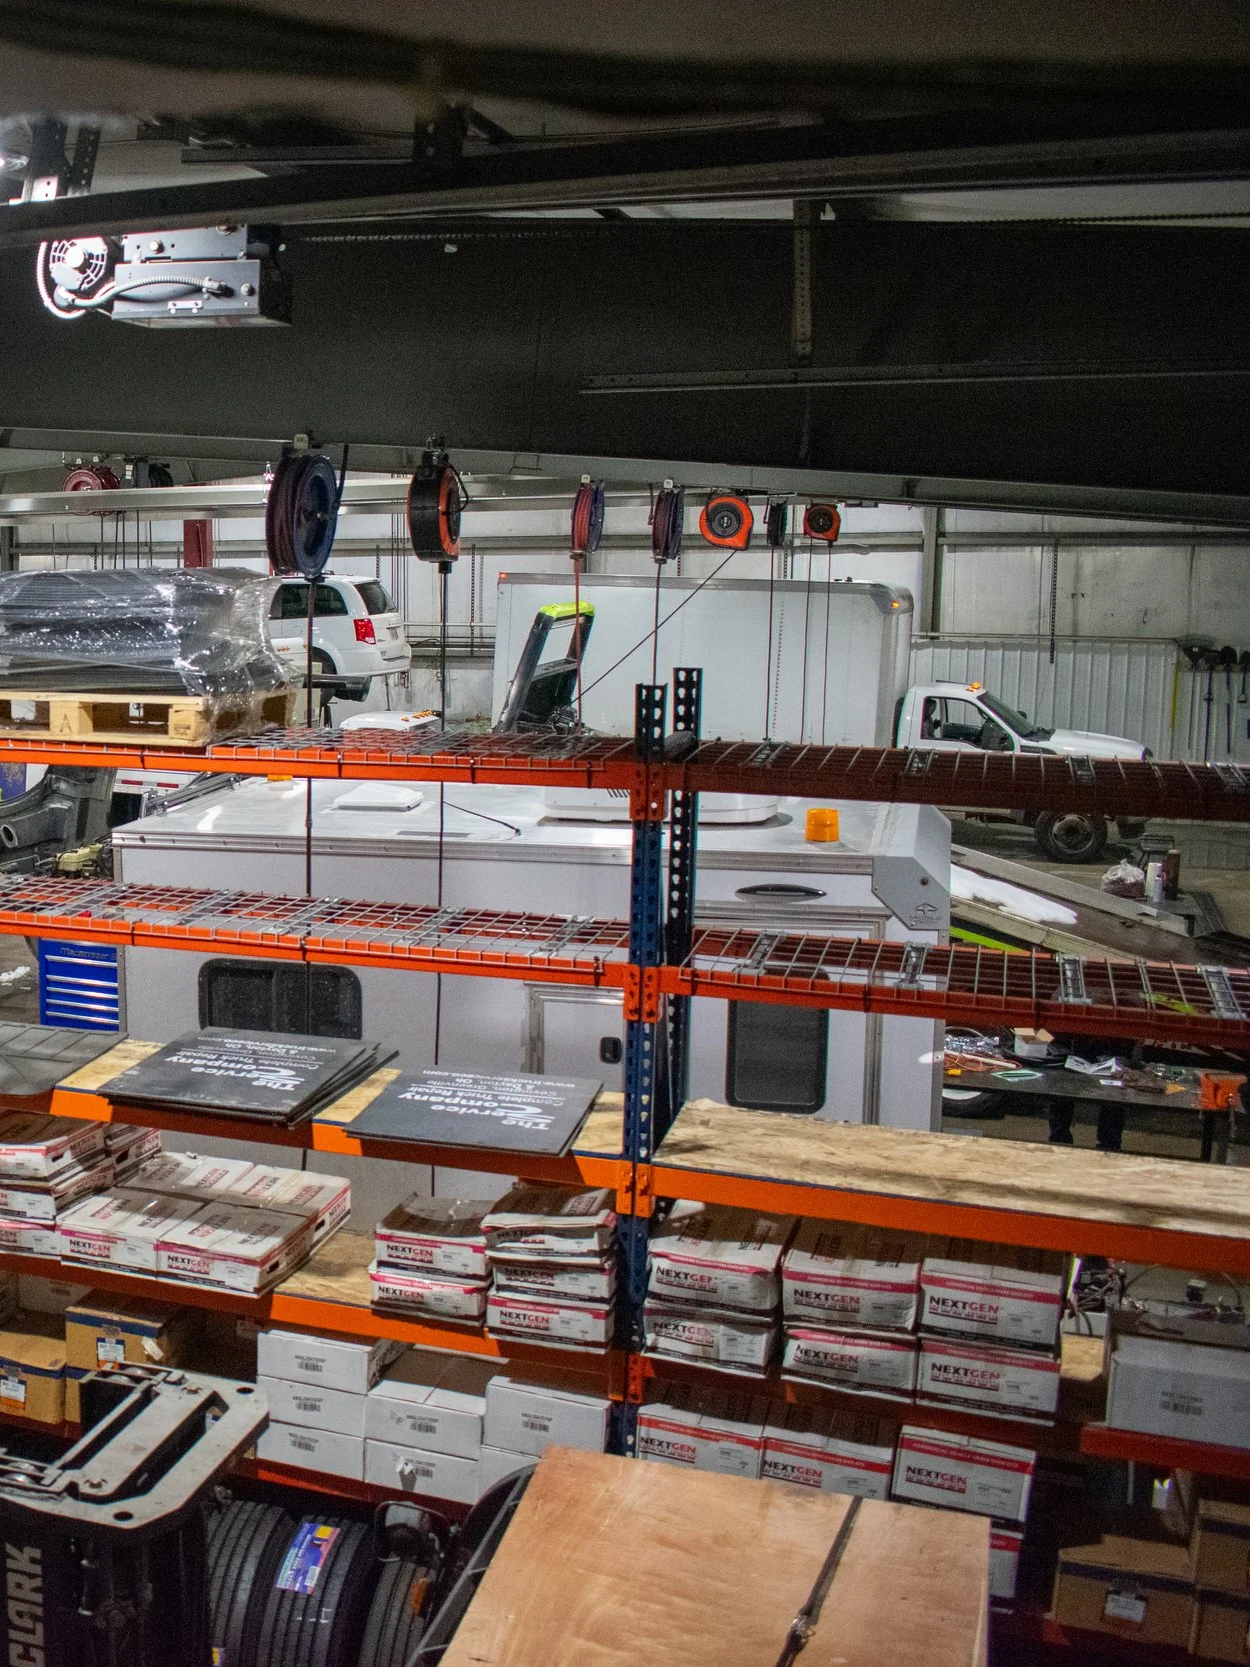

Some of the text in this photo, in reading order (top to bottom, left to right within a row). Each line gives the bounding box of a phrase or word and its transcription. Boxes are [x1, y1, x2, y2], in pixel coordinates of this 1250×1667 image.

[165, 1055, 297, 1076] Company
[220, 1054, 255, 1064] Truck
[252, 1079, 295, 1091] The
[398, 1091, 543, 1114] Company
[455, 1090, 494, 1101] Truck
[501, 1118, 550, 1130] The
[69, 1239, 110, 1252] NEXTGEN
[386, 1244, 433, 1257] NEXTGEN
[167, 1255, 210, 1268] NEXTGEN
[378, 1286, 424, 1299] NEXTGEN
[793, 1289, 860, 1305] NEXTGEN
[929, 1295, 999, 1313] NEXTGEN
[500, 1310, 550, 1323] NEXTGEN
[795, 1344, 858, 1362] NEXTGEN
[931, 1362, 999, 1379] NEXTGEN
[640, 1436, 697, 1453] NEXTGEN
[763, 1459, 822, 1477] NEXTGEN
[906, 1465, 967, 1485] NEXTGEN
[4, 1542, 45, 1667] CLARK
